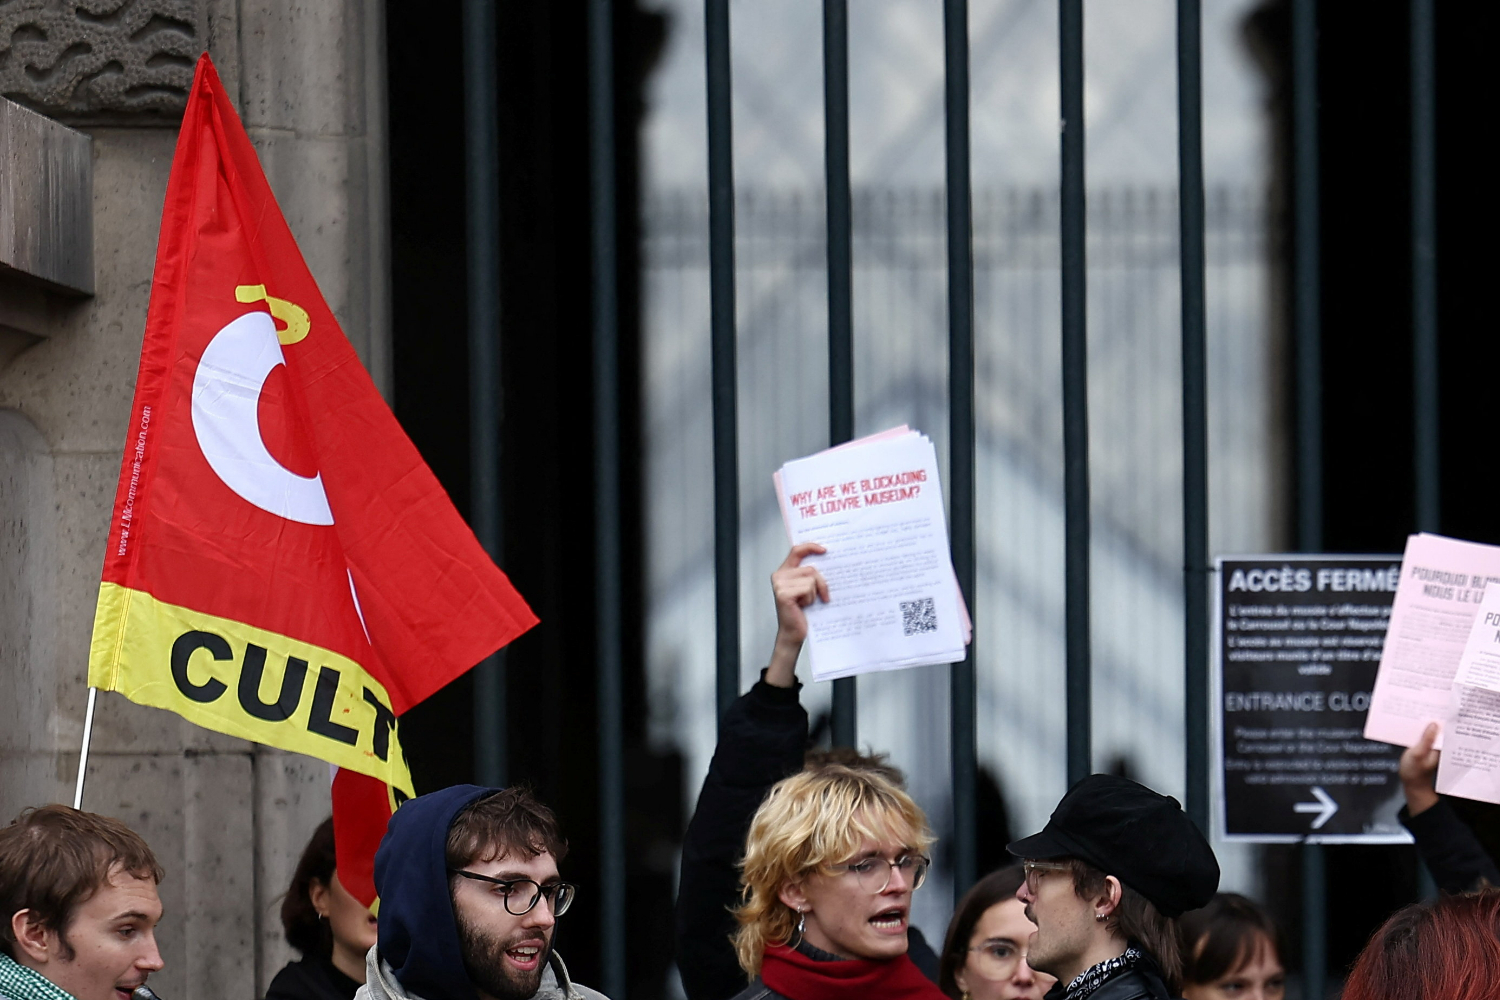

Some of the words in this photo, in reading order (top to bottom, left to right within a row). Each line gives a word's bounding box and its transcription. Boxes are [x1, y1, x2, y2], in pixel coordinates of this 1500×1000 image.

[790, 490, 813, 507] WHY
[816, 485, 837, 501] ARE
[840, 481, 858, 496] WE
[860, 469, 928, 493] BLOCKADING
[799, 504, 818, 519] THE
[820, 496, 861, 515] LOUVRE
[864, 485, 921, 507] MUSEUM?
[1228, 565, 1312, 592] ACCÈS
[1317, 565, 1399, 592] FERMÉ
[1411, 566, 1468, 588] POURQUOI
[1423, 584, 1454, 601] NOUS
[1457, 589, 1471, 604] LE
[1226, 692, 1325, 711] ENTRANCE
